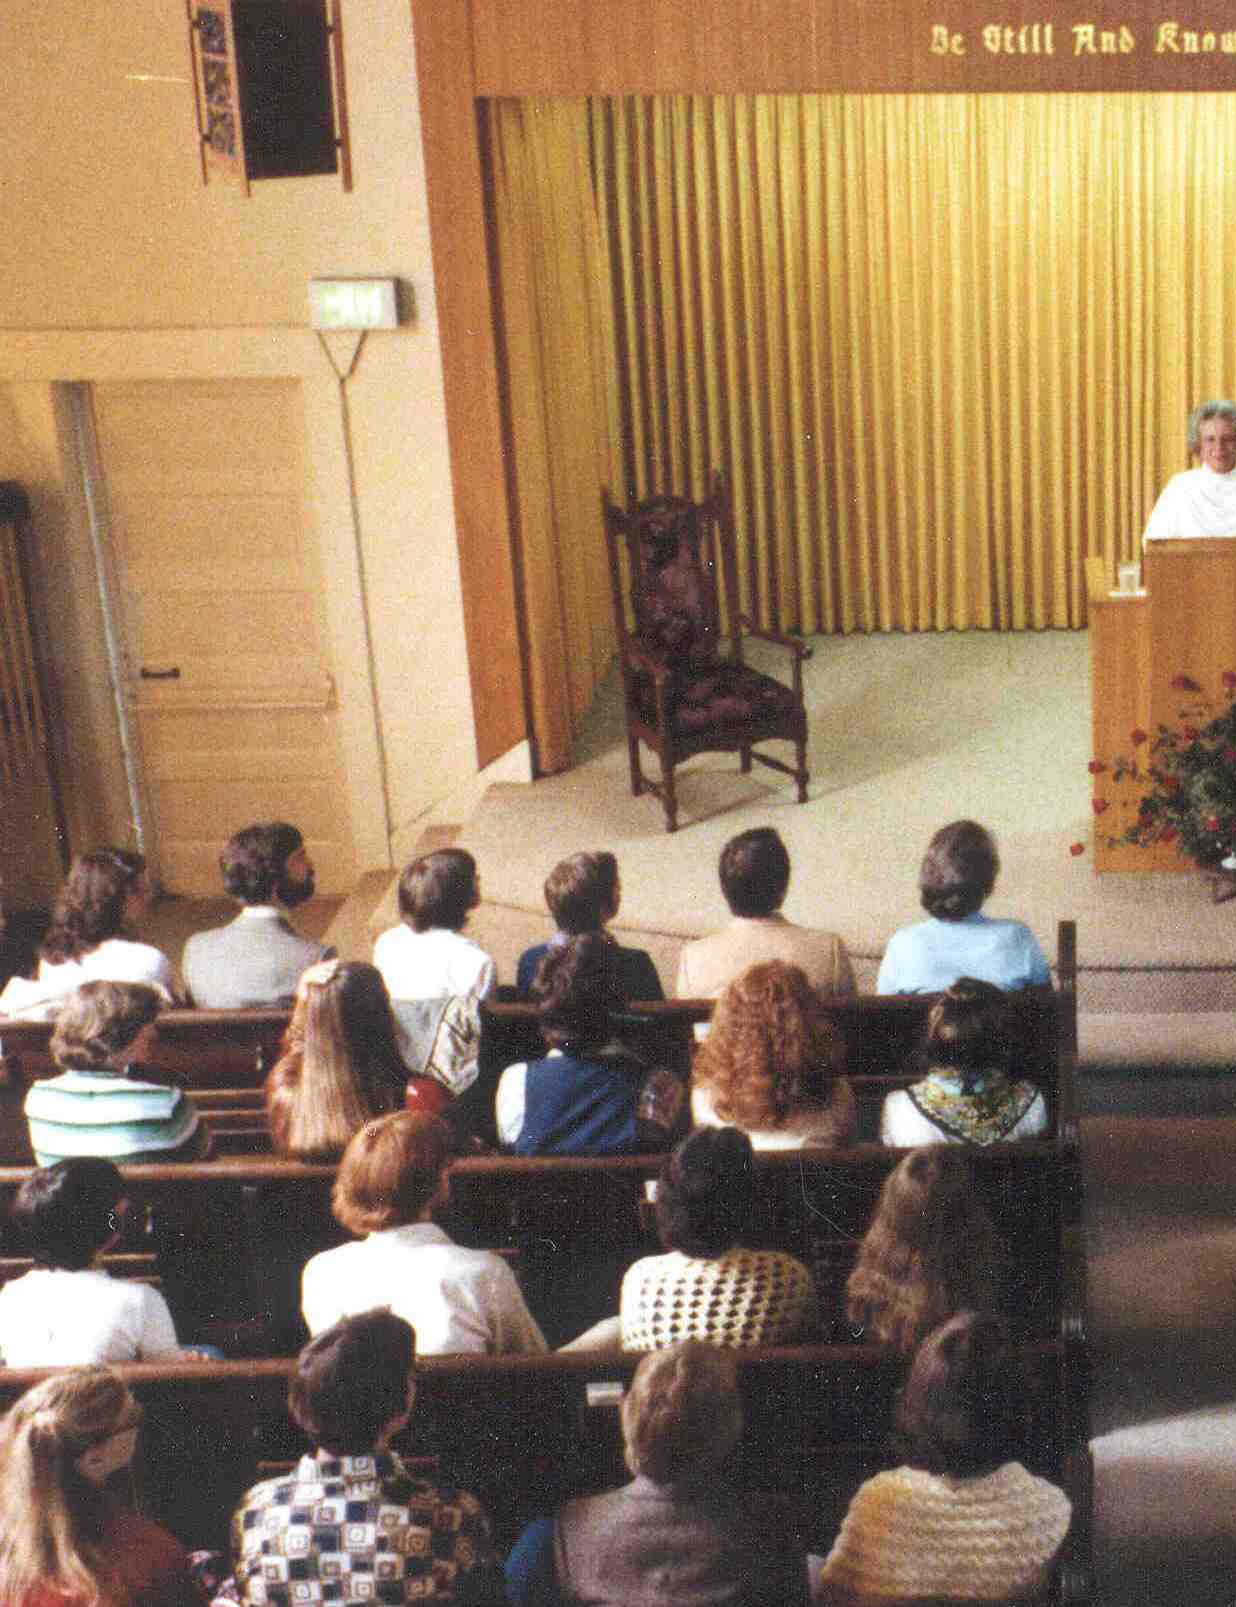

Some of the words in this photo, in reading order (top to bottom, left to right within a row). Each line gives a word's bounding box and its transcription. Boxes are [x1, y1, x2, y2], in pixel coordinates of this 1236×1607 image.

[930, 23, 966, 56] Be
[981, 23, 1056, 55] Still
[1071, 22, 1135, 56] And
